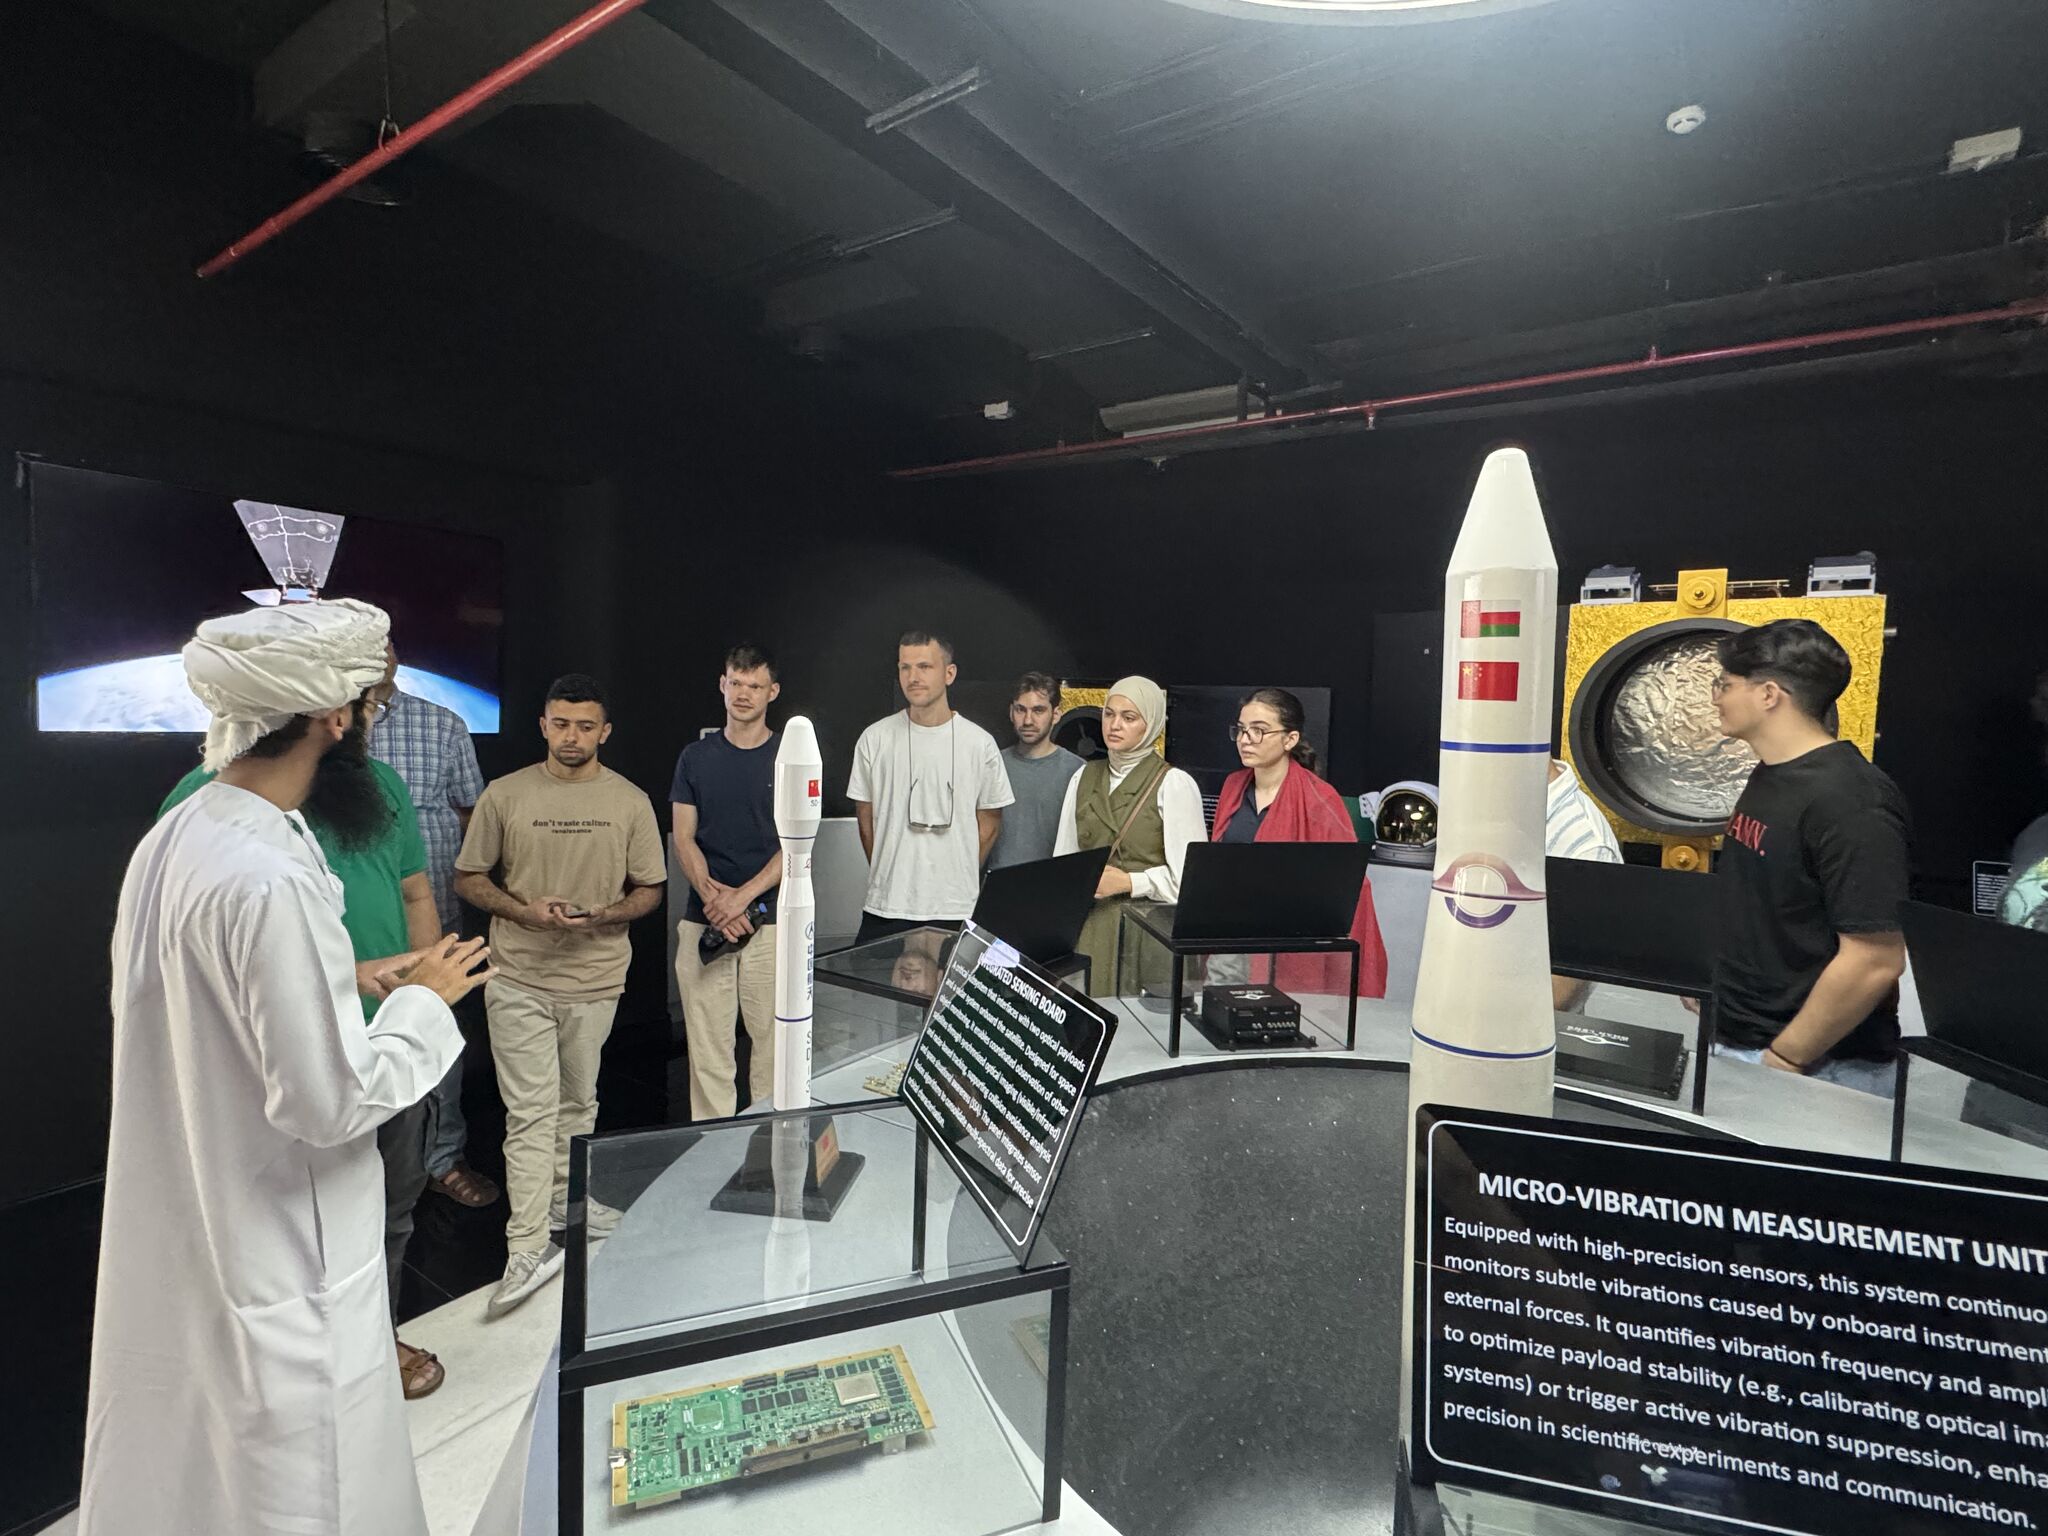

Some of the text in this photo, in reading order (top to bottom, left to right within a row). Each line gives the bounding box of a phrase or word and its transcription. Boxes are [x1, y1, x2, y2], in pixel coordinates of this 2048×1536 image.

[532, 819, 556, 827] don't
[581, 819, 612, 827] culture
[1010, 975, 1041, 1005] SENSING
[1038, 995, 1066, 1024] BOARD
[996, 1020, 1005, 1033] the
[1024, 1044, 1051, 1073] Designed
[1048, 1064, 1059, 1080] for
[1057, 1075, 1076, 1096] space
[1017, 1013, 1030, 1028] with
[1028, 1021, 1040, 1036] two
[1039, 1031, 1060, 1051] optical
[1056, 1045, 1085, 1072] payloads
[984, 1062, 1001, 1080] optical
[998, 1073, 1018, 1101] imaging
[1016, 1091, 1061, 1142] (visible/infrared)
[987, 1091, 1006, 1115] collision
[1005, 1110, 1030, 1141] avoidance
[1029, 1135, 1051, 1163] analysis
[1014, 1063, 1045, 1096] observation
[1044, 1091, 1053, 1101] of
[1050, 1097, 1068, 1116] other
[980, 1109, 990, 1126] The
[987, 1120, 1003, 1139] panel
[1000, 1132, 1024, 1165] integrates
[1022, 1159, 1042, 1183] sensor
[994, 1156, 1007, 1175] data
[1005, 1168, 1015, 1184] for
[1012, 1180, 1034, 1208] precise
[1478, 1172, 2048, 1274] MICRO-VIBRATION MEASUREMENT UNIT
[1444, 1255, 1530, 1280] monitors
[1535, 1268, 1596, 1291] subtle
[1601, 1278, 1703, 1308] vibrations
[1709, 1297, 1782, 1321] caused
[1789, 1304, 1815, 1330] by
[1821, 1314, 1916, 1342] onboard
[1445, 1216, 2047, 1323] Equipped with high-precision sensors, this system continuo
[1443, 1324, 1463, 1342] to
[1469, 1331, 1554, 1358] optimize
[1561, 1347, 1641, 1374] payload
[1647, 1361, 1731, 1393] stability
[1738, 1373, 1792, 1405] (e.g.,
[1799, 1390, 1920, 1429] calibrating
[1925, 1413, 2006, 1440] optical
[1444, 1291, 1519, 1315] external
[1525, 1300, 1589, 1327] forces.
[1596, 1314, 1610, 1332] It
[1615, 1321, 1716, 1350] quantifies
[1720, 1336, 1815, 1367] vibration
[1820, 1350, 1932, 1390] frequency
[1939, 1375, 1982, 1395] and
[1443, 1364, 2048, 1488] systems) or trigger active vibration suppression, enha
[1444, 1401, 2036, 1529] precision in scientific experiments and communication.
